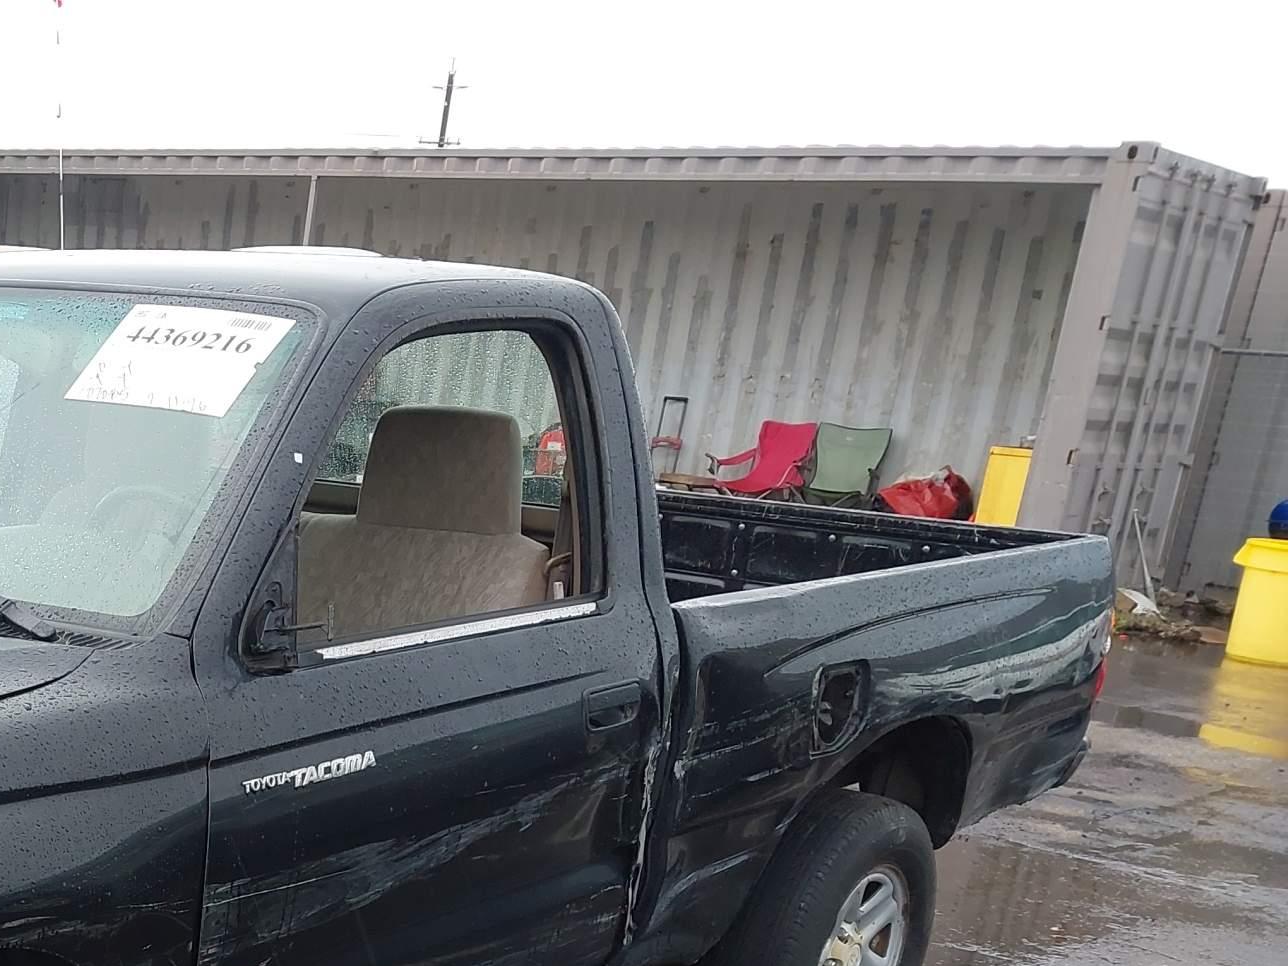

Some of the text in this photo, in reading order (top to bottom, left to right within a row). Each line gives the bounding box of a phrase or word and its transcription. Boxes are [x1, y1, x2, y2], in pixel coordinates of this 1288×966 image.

[126, 326, 256, 354] 44369216
[242, 750, 377, 794] TOYOTA TACOMA
